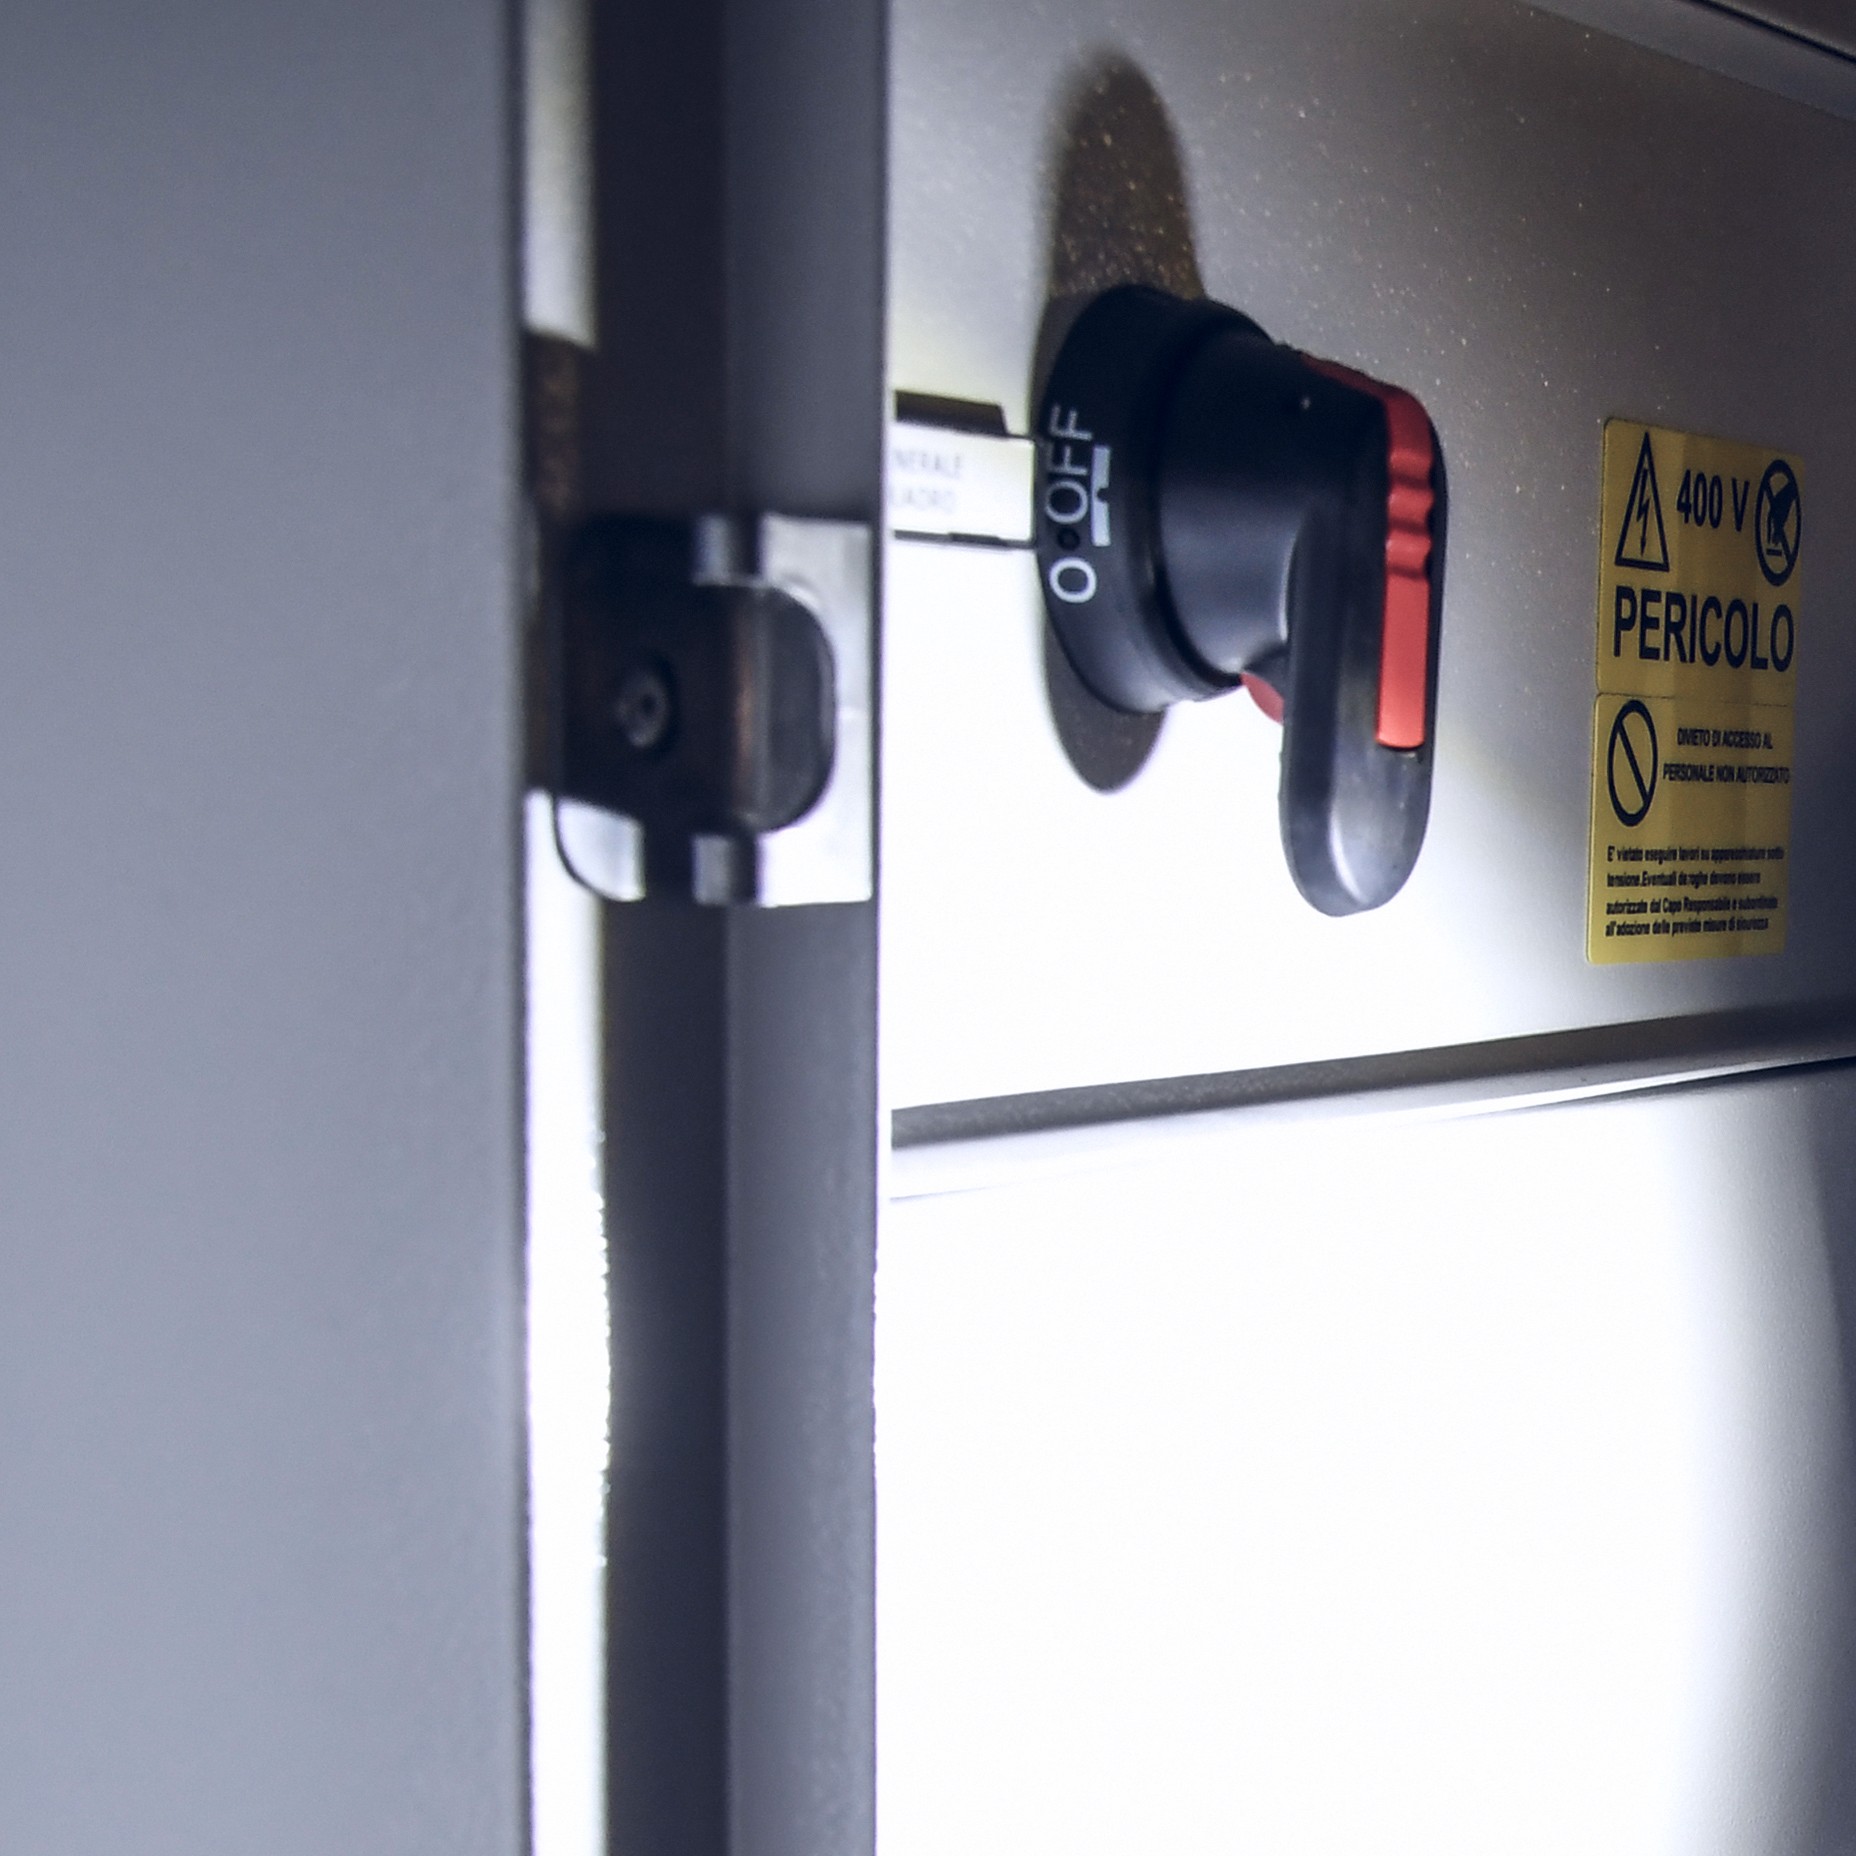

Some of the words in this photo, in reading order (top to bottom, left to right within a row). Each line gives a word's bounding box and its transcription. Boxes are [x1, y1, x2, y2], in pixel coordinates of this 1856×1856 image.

[1045, 403, 1093, 524] OFF
[1676, 468, 1723, 529] 400
[1731, 477, 1750, 532] V
[1613, 584, 1794, 672] PERICOLO
[1677, 727, 1710, 747] DIVIETO
[1712, 729, 1721, 748] DI
[1722, 731, 1761, 749] ACCESSO
[1763, 733, 1773, 749] AL
[1663, 763, 1714, 782] PERSONALE
[1716, 764, 1735, 783] NON
[1736, 765, 1790, 784] AUTORIZZATO
[1662, 897, 1682, 915] Capo
